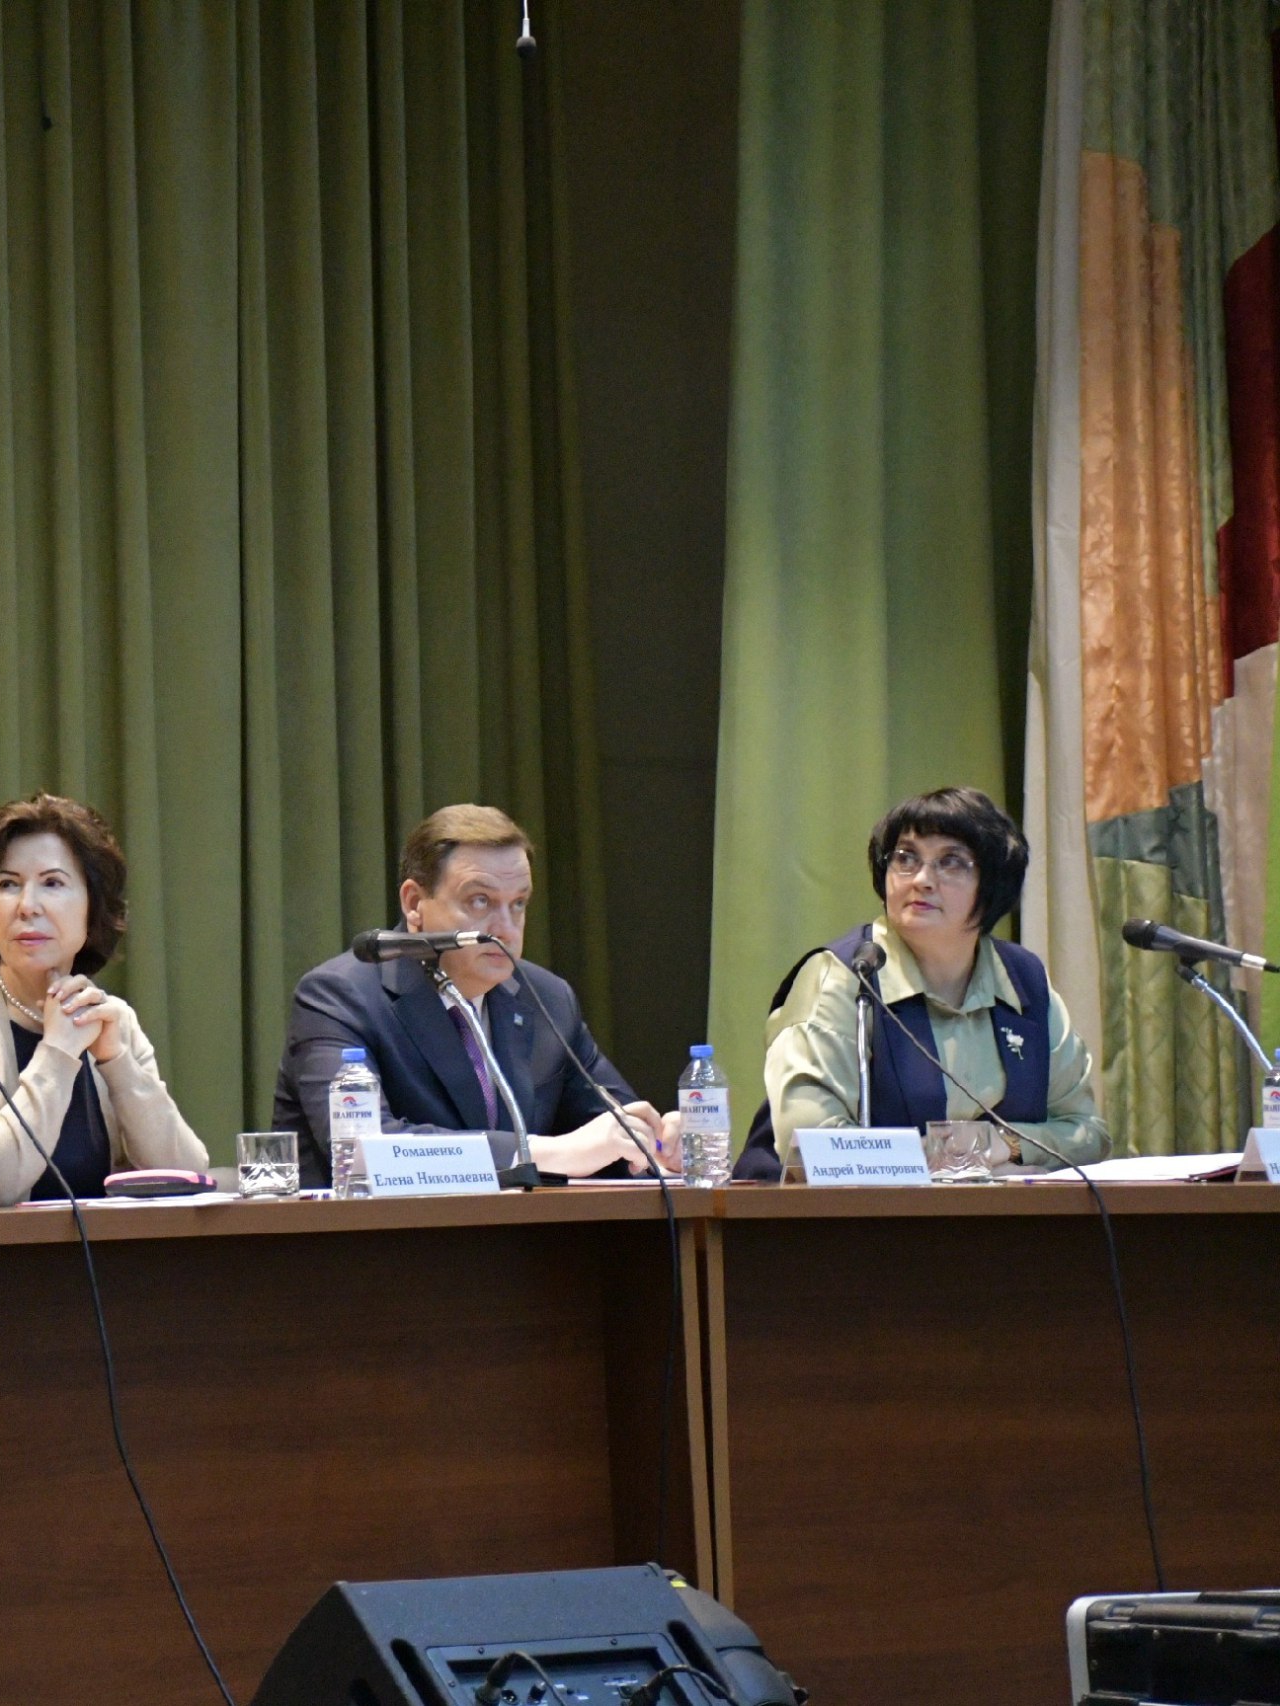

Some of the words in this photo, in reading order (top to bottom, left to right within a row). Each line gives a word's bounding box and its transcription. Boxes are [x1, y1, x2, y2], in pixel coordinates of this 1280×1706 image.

[830, 1136, 892, 1150] Милёхин
[392, 1145, 463, 1158] Романенко
[812, 1164, 854, 1178] Андрей
[856, 1164, 924, 1176] Викторович
[374, 1173, 414, 1187] Елена
[417, 1171, 494, 1186] Николаевна
